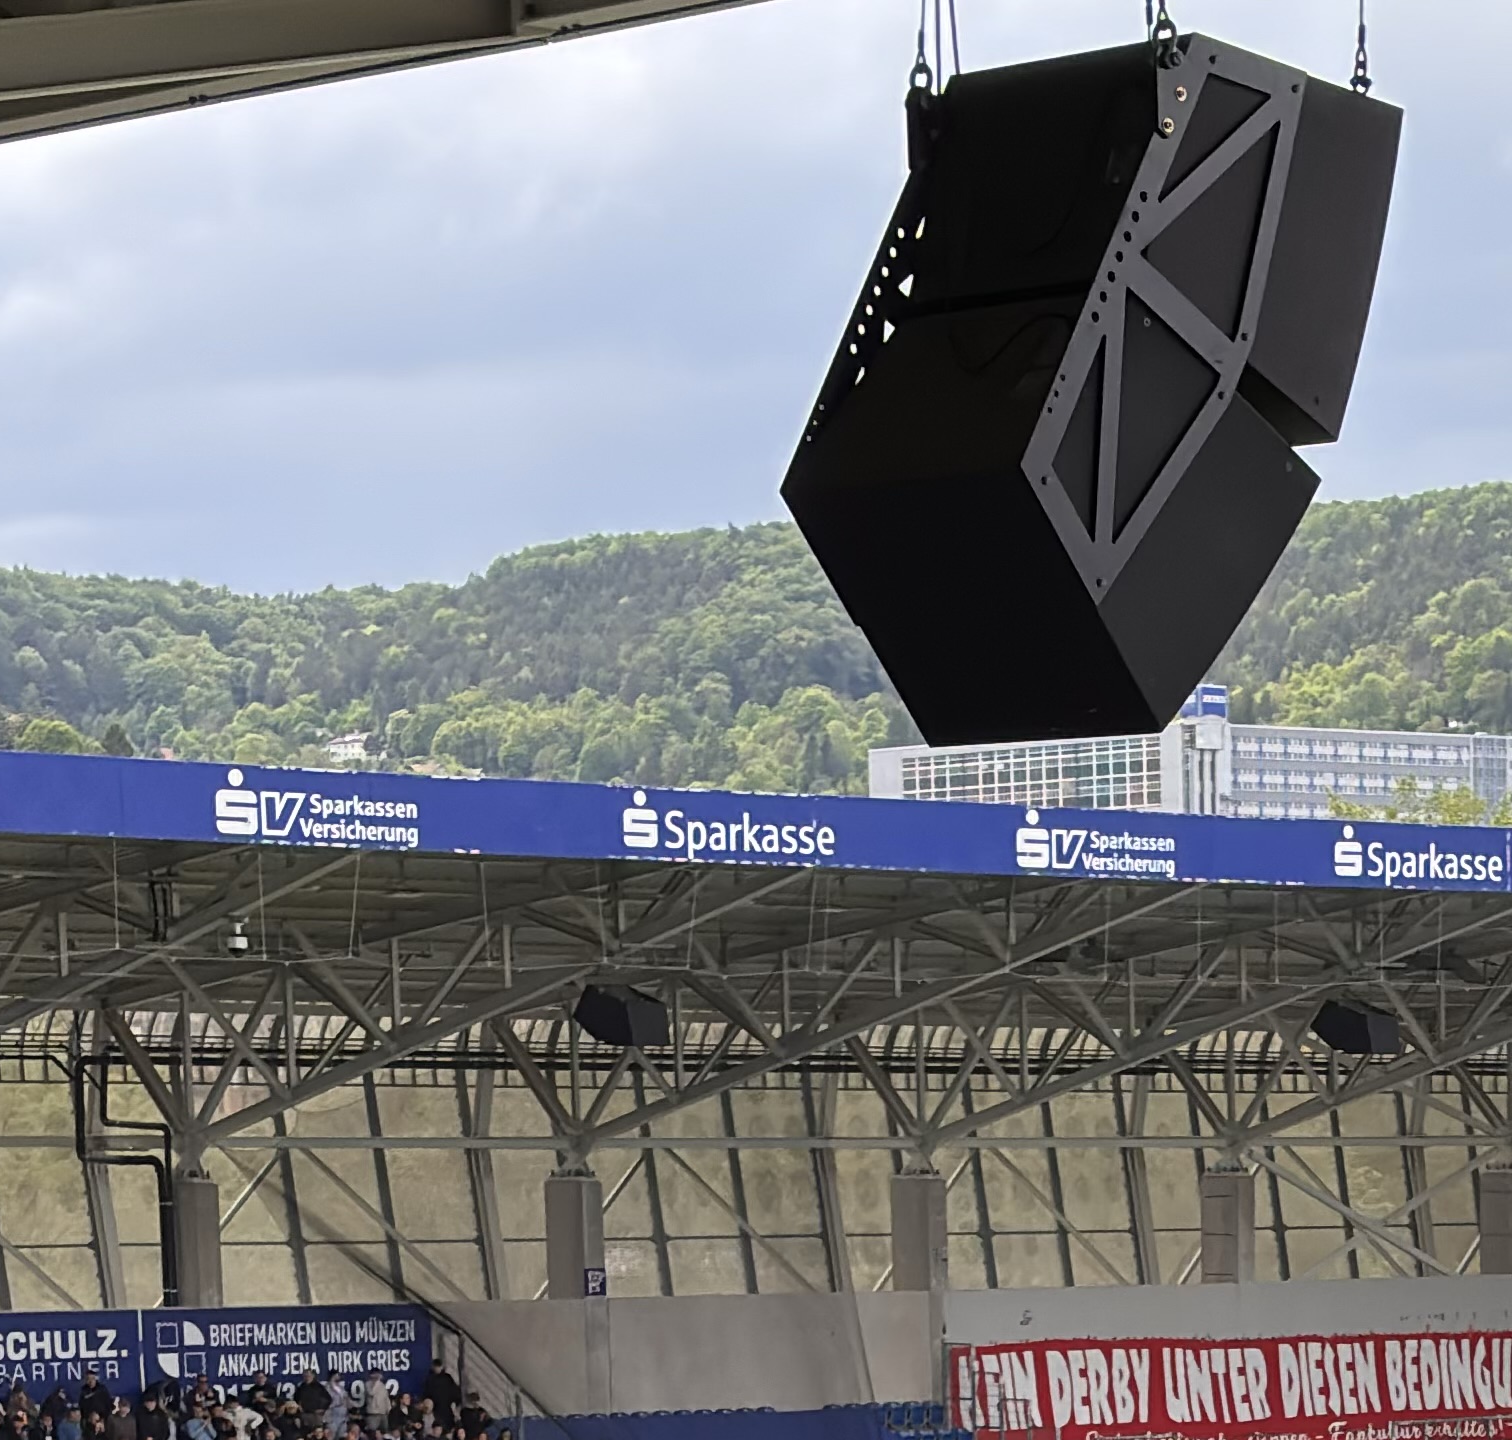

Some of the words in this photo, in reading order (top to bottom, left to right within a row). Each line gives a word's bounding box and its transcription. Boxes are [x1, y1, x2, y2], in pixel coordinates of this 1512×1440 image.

[308, 791, 418, 823] Sparkassen
[299, 815, 420, 848] Versicherung
[663, 809, 835, 860] Sparkasse
[1088, 829, 1176, 854] Sparkassen
[1082, 851, 1176, 877] Versicherung
[1367, 842, 1503, 885] Sparkasse
[209, 1321, 317, 1347] BRIEFMARKEN
[320, 1321, 351, 1344] UND
[355, 1317, 415, 1344] MÜNZEN
[218, 1352, 277, 1377] ANKAUF
[282, 1350, 320, 1375] JENA
[367, 1349, 411, 1372] GRIES
[1046, 1346, 1150, 1428] DERBY
[1162, 1345, 1269, 1424] UNTER
[1278, 1339, 1384, 1419] DIESEN
